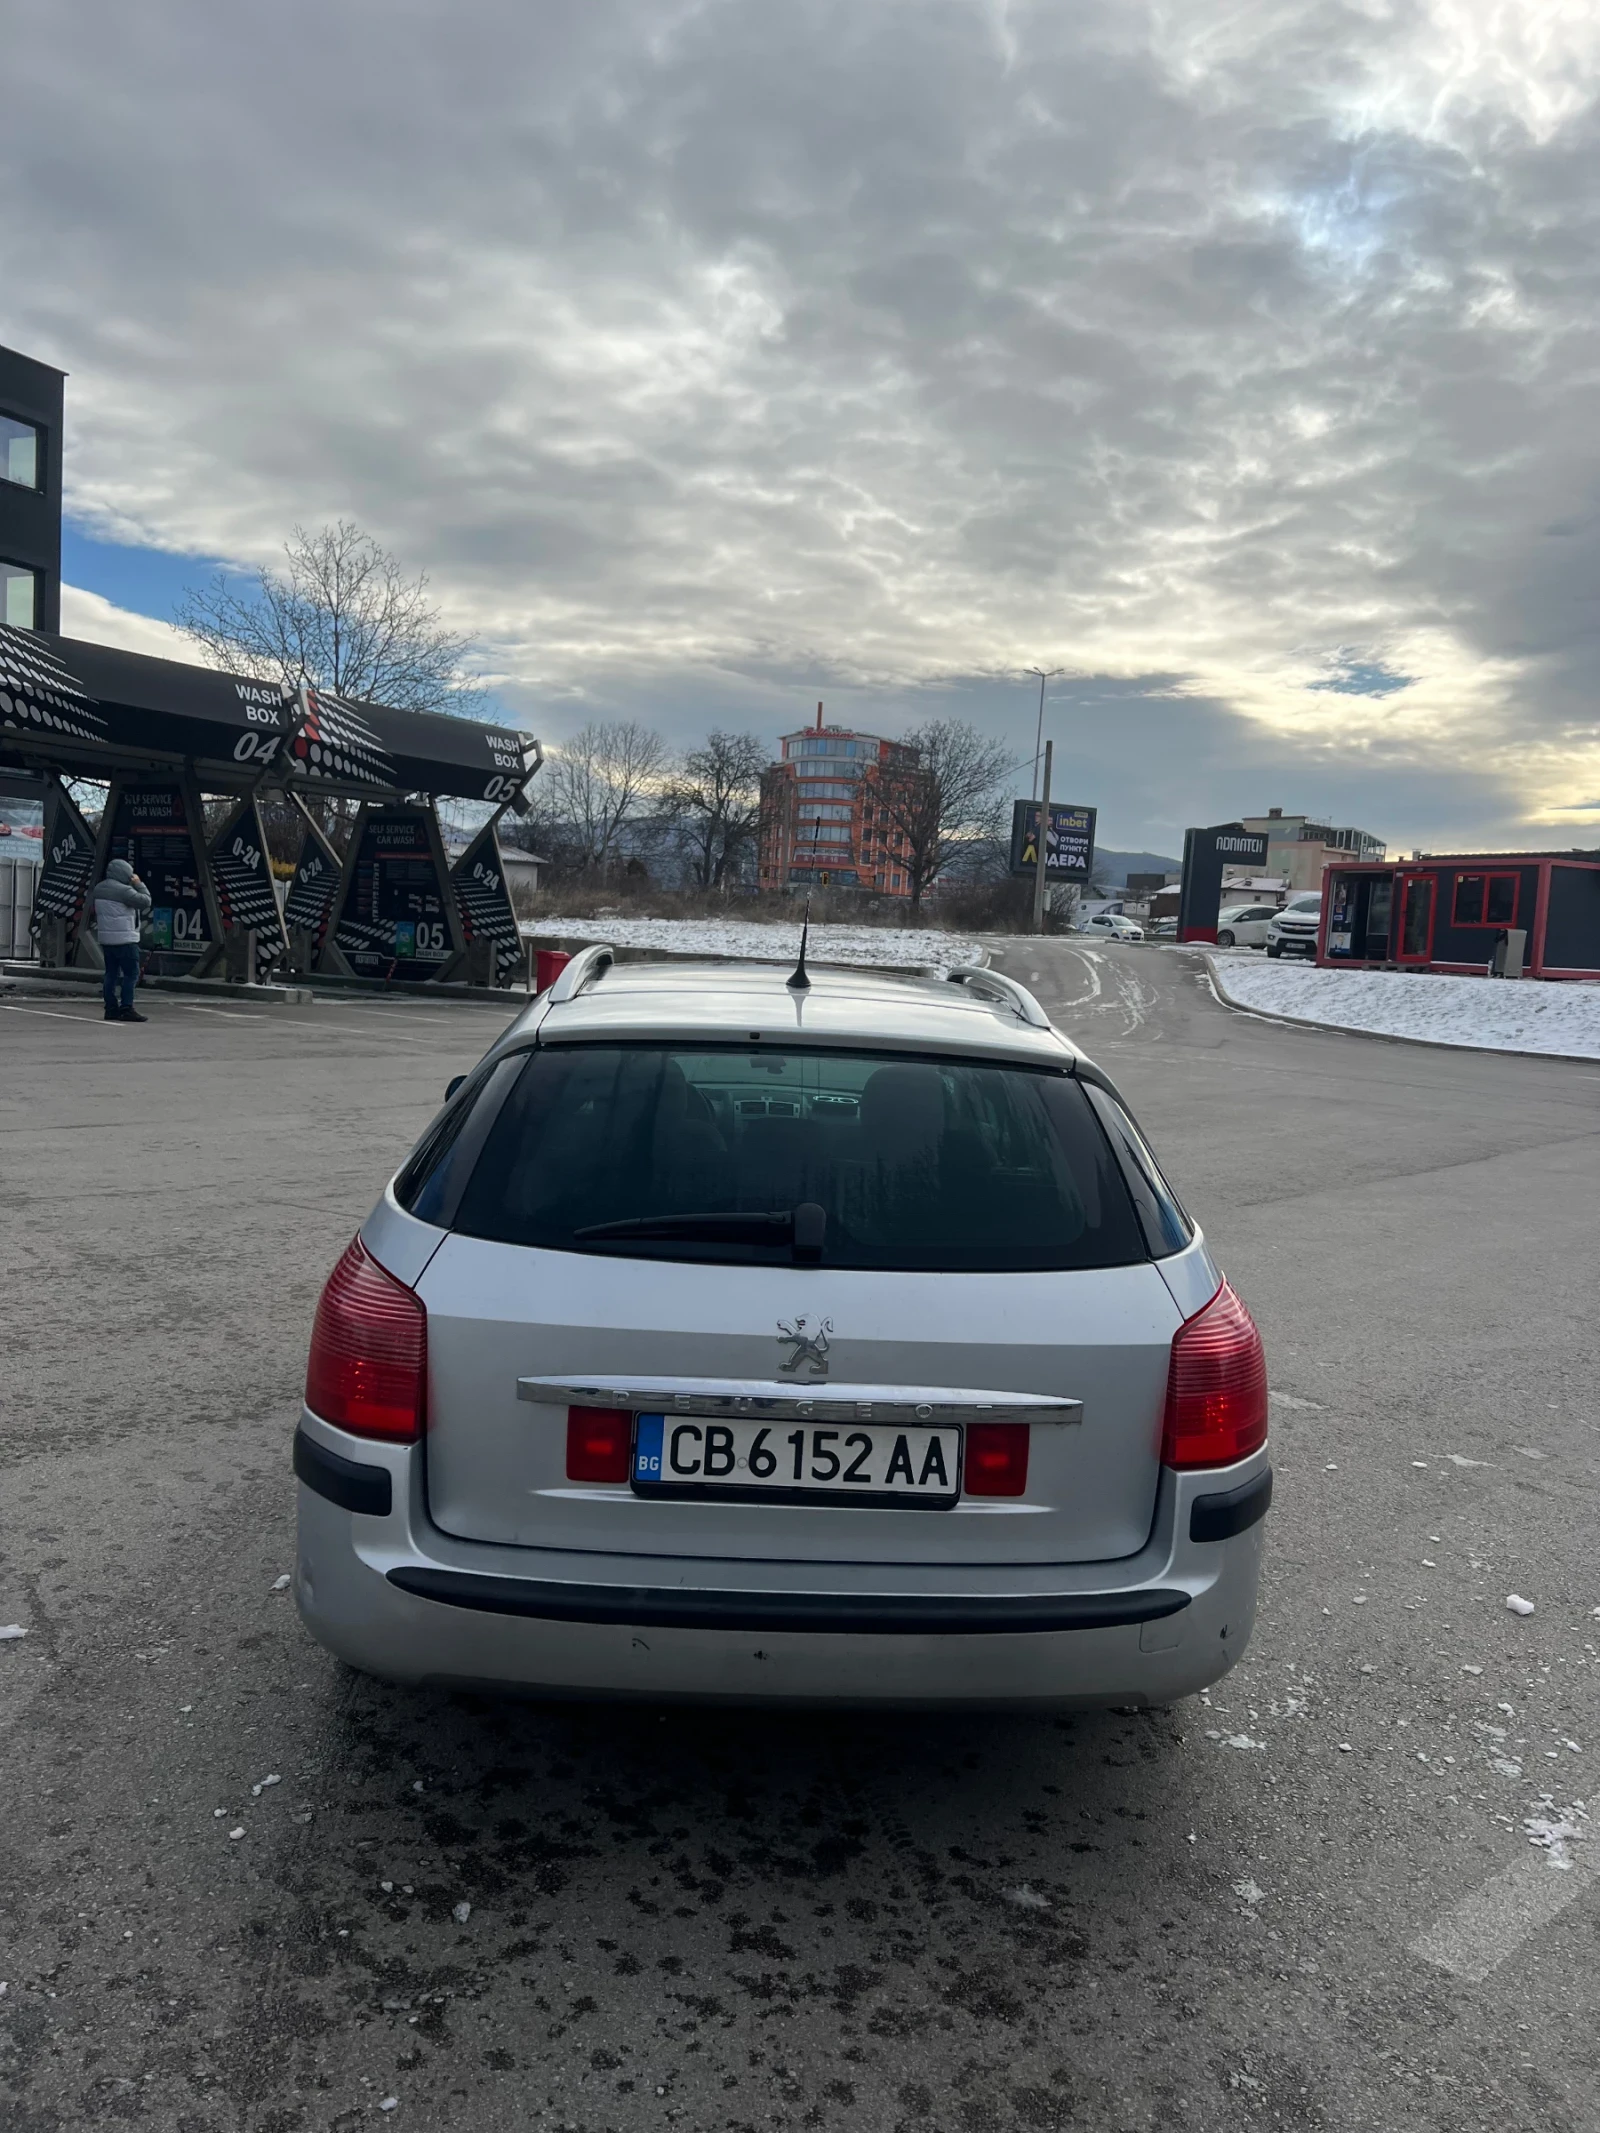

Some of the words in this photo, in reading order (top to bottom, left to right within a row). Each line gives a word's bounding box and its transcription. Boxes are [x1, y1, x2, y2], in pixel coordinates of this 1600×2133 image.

[235, 684, 283, 707] WASH
[246, 706, 280, 725] BOX
[233, 732, 280, 764] 04
[485, 735, 521, 753] WASH
[494, 753, 519, 769] BOX
[483, 775, 521, 801] 05
[142, 794, 172, 804] SERVICE
[132, 807, 147, 816] CAR
[149, 807, 172, 817] WASH
[1059, 815, 1087, 828] inbet
[368, 825, 384, 833] SELF
[386, 825, 415, 834] SERVICE
[52, 833, 77, 864] 0-24
[377, 836, 391, 844] CAR
[393, 836, 415, 844] WASH
[1060, 836, 1089, 845] ОТВОРИ
[232, 837, 260, 870] 0-24
[300, 857, 323, 884] 0-24
[473, 862, 500, 891] 0-24
[174, 908, 203, 940] 04
[416, 922, 444, 949] 05
[191, 941, 203, 950] BOX
[638, 1455, 660, 1472] BG
[669, 1425, 736, 1477] CB
[747, 1428, 875, 1483] 6152
[884, 1434, 949, 1486] AA
